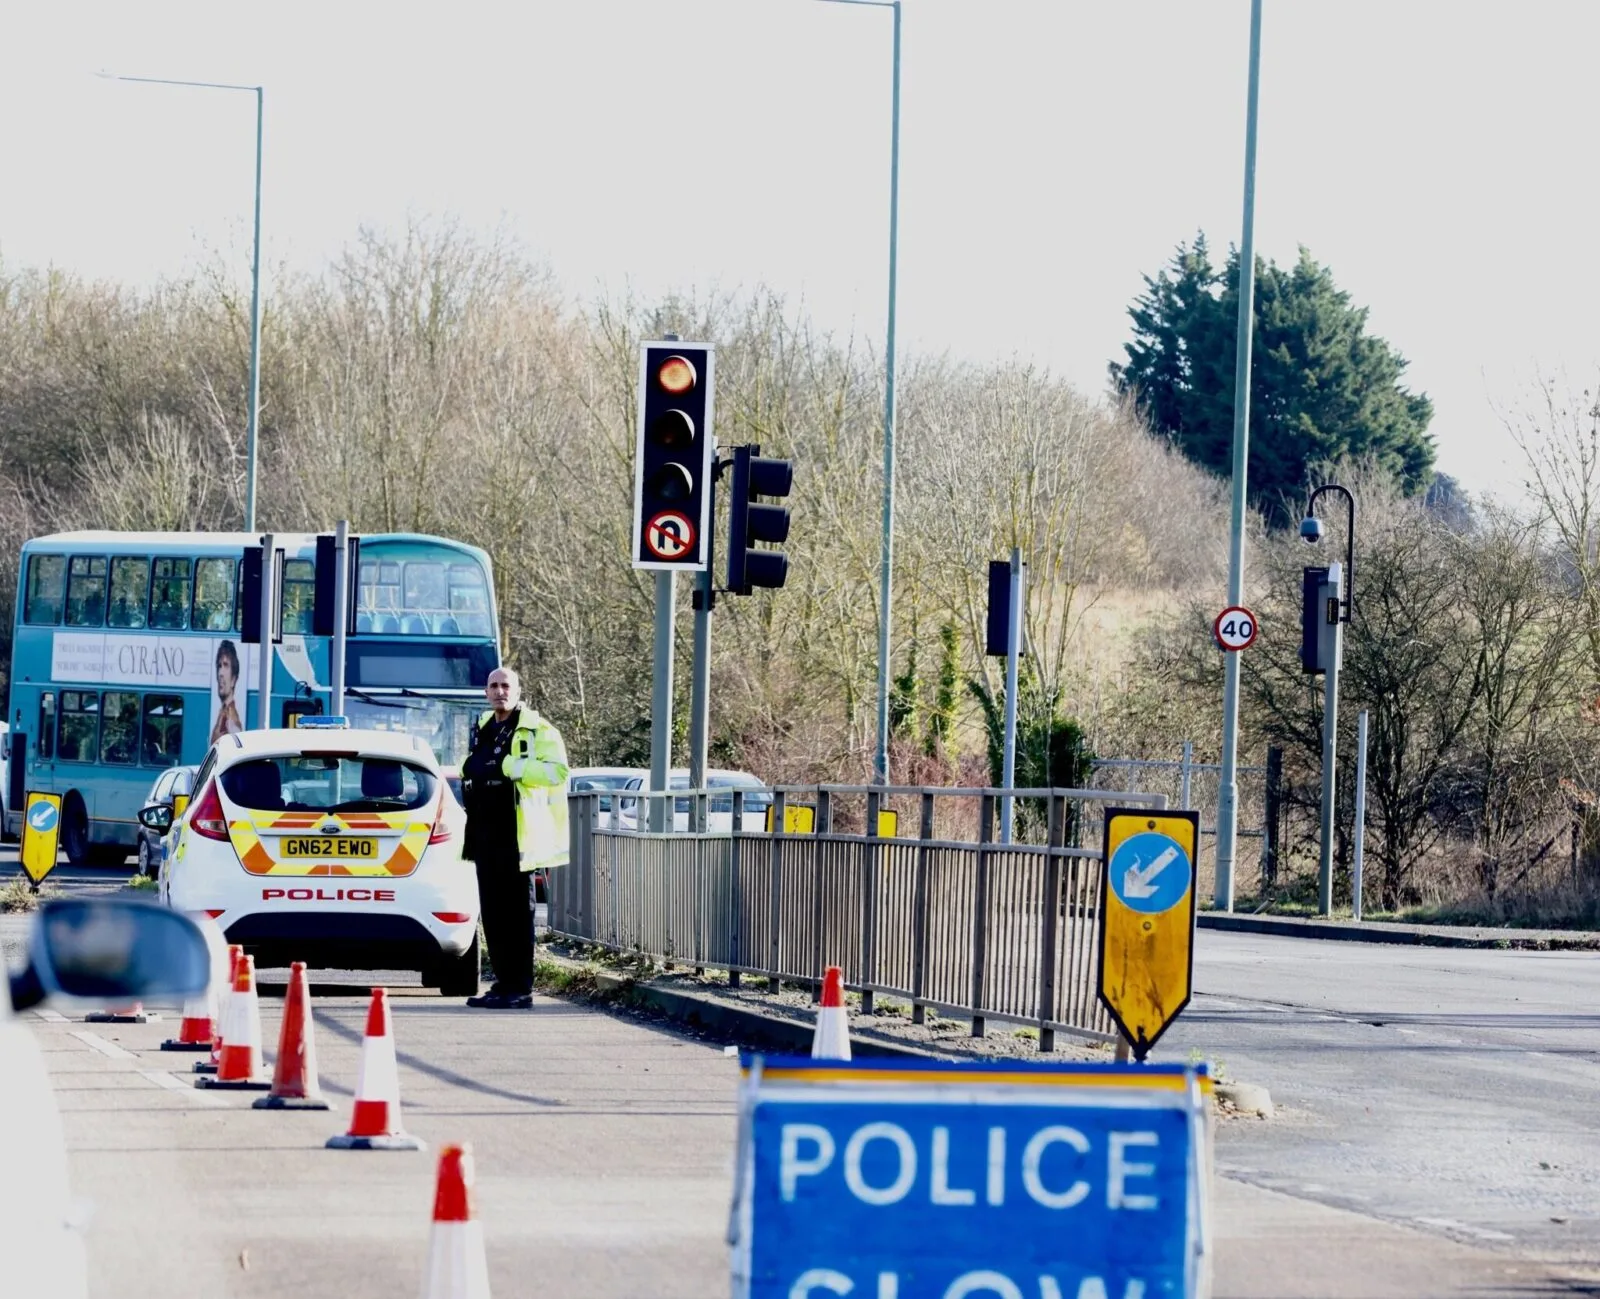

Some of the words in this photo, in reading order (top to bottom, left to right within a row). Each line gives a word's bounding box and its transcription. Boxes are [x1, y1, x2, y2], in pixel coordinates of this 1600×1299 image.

[1222, 620, 1253, 639] 40
[118, 644, 184, 677] CYRANO
[287, 839, 332, 855] GN62
[337, 840, 372, 856] EWO
[262, 888, 396, 902] POLICE
[778, 1121, 1160, 1211] POLICE
